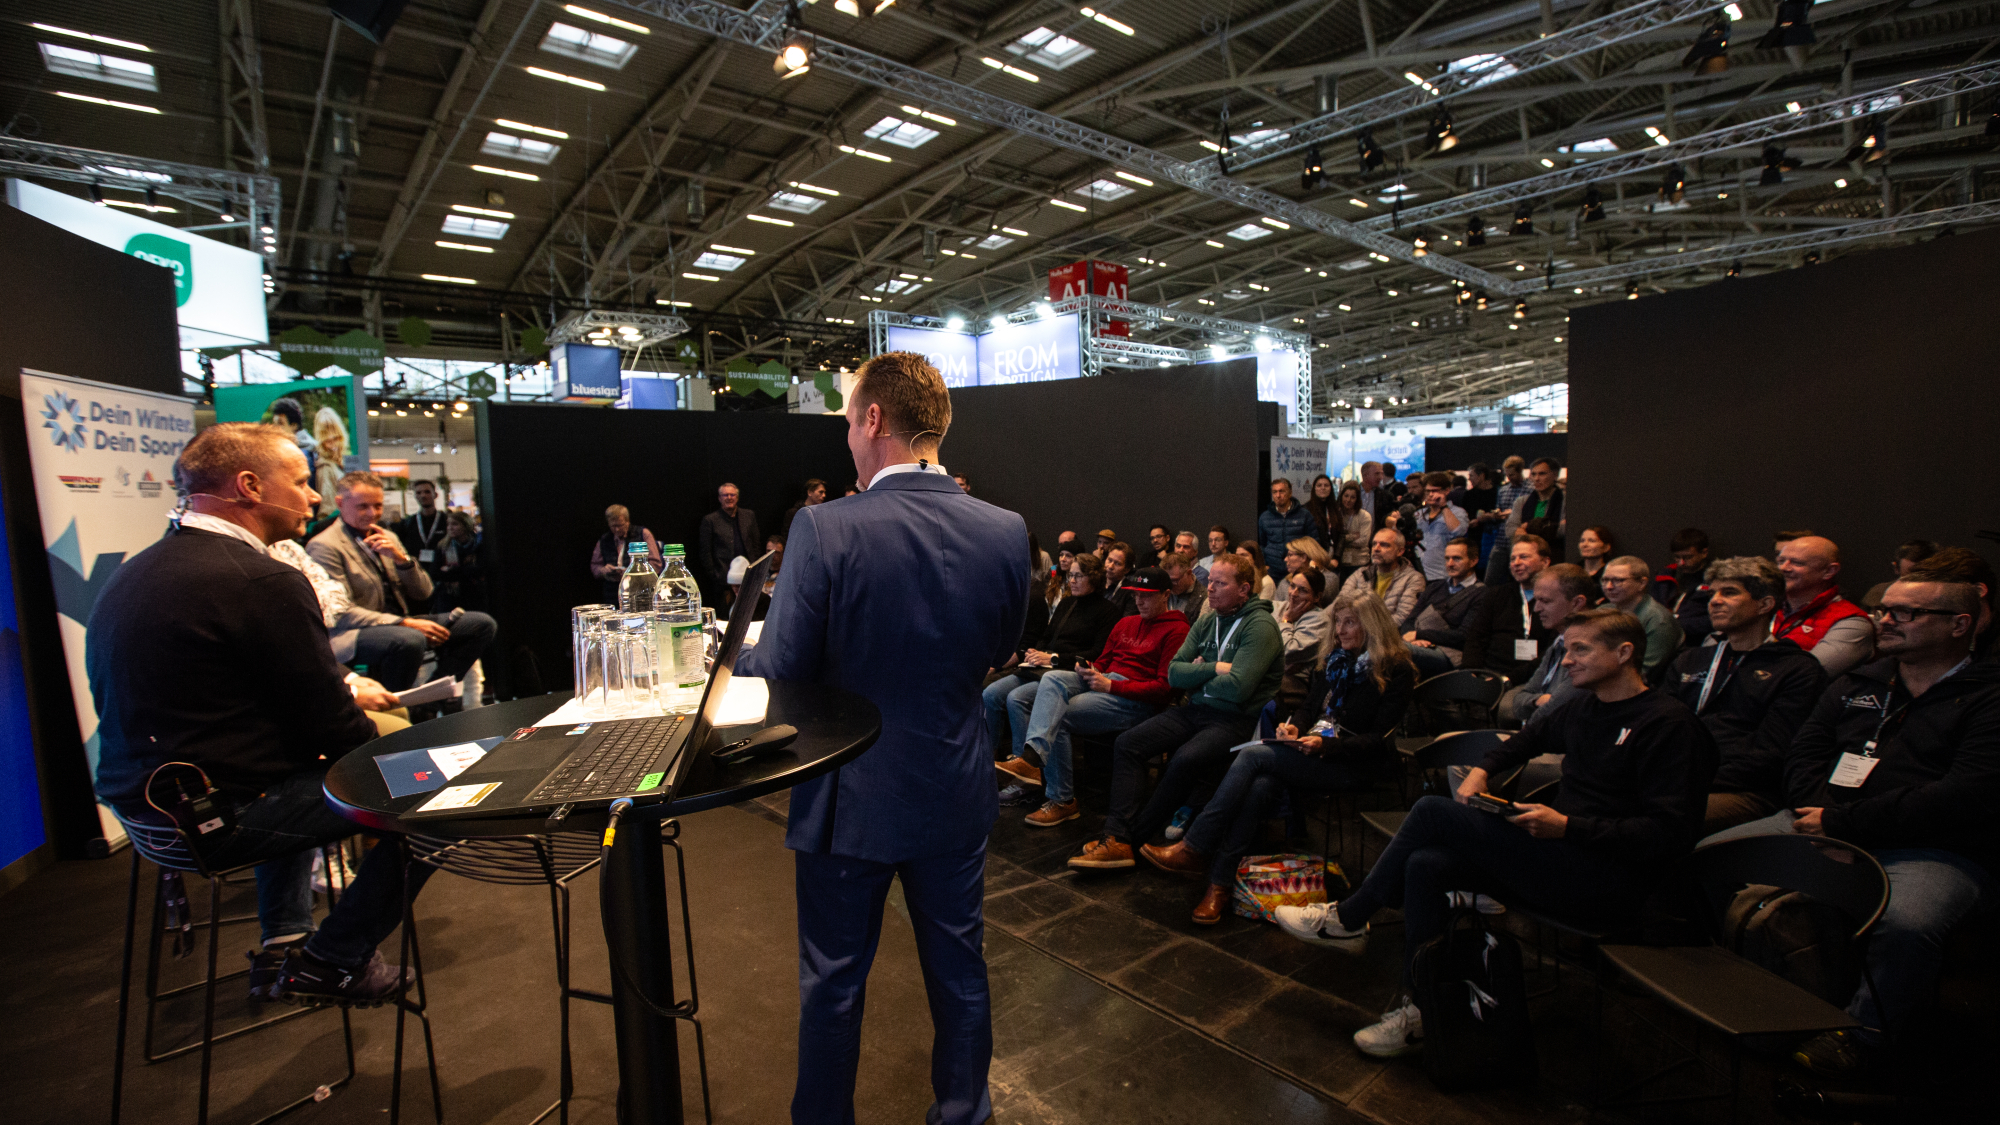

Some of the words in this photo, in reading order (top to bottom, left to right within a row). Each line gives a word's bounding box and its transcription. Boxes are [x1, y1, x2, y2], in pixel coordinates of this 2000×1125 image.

[1062, 279, 1086, 300] A1
[1106, 281, 1127, 301] A1
[281, 343, 379, 356] SUSTAINABILITY
[994, 341, 1059, 376] FROM
[728, 371, 786, 381] SUSTAINABILITY
[89, 401, 131, 426] Dein
[94, 429, 136, 453] Dein
[1291, 447, 1306, 458] Dein
[1291, 461, 1305, 471] Dein
